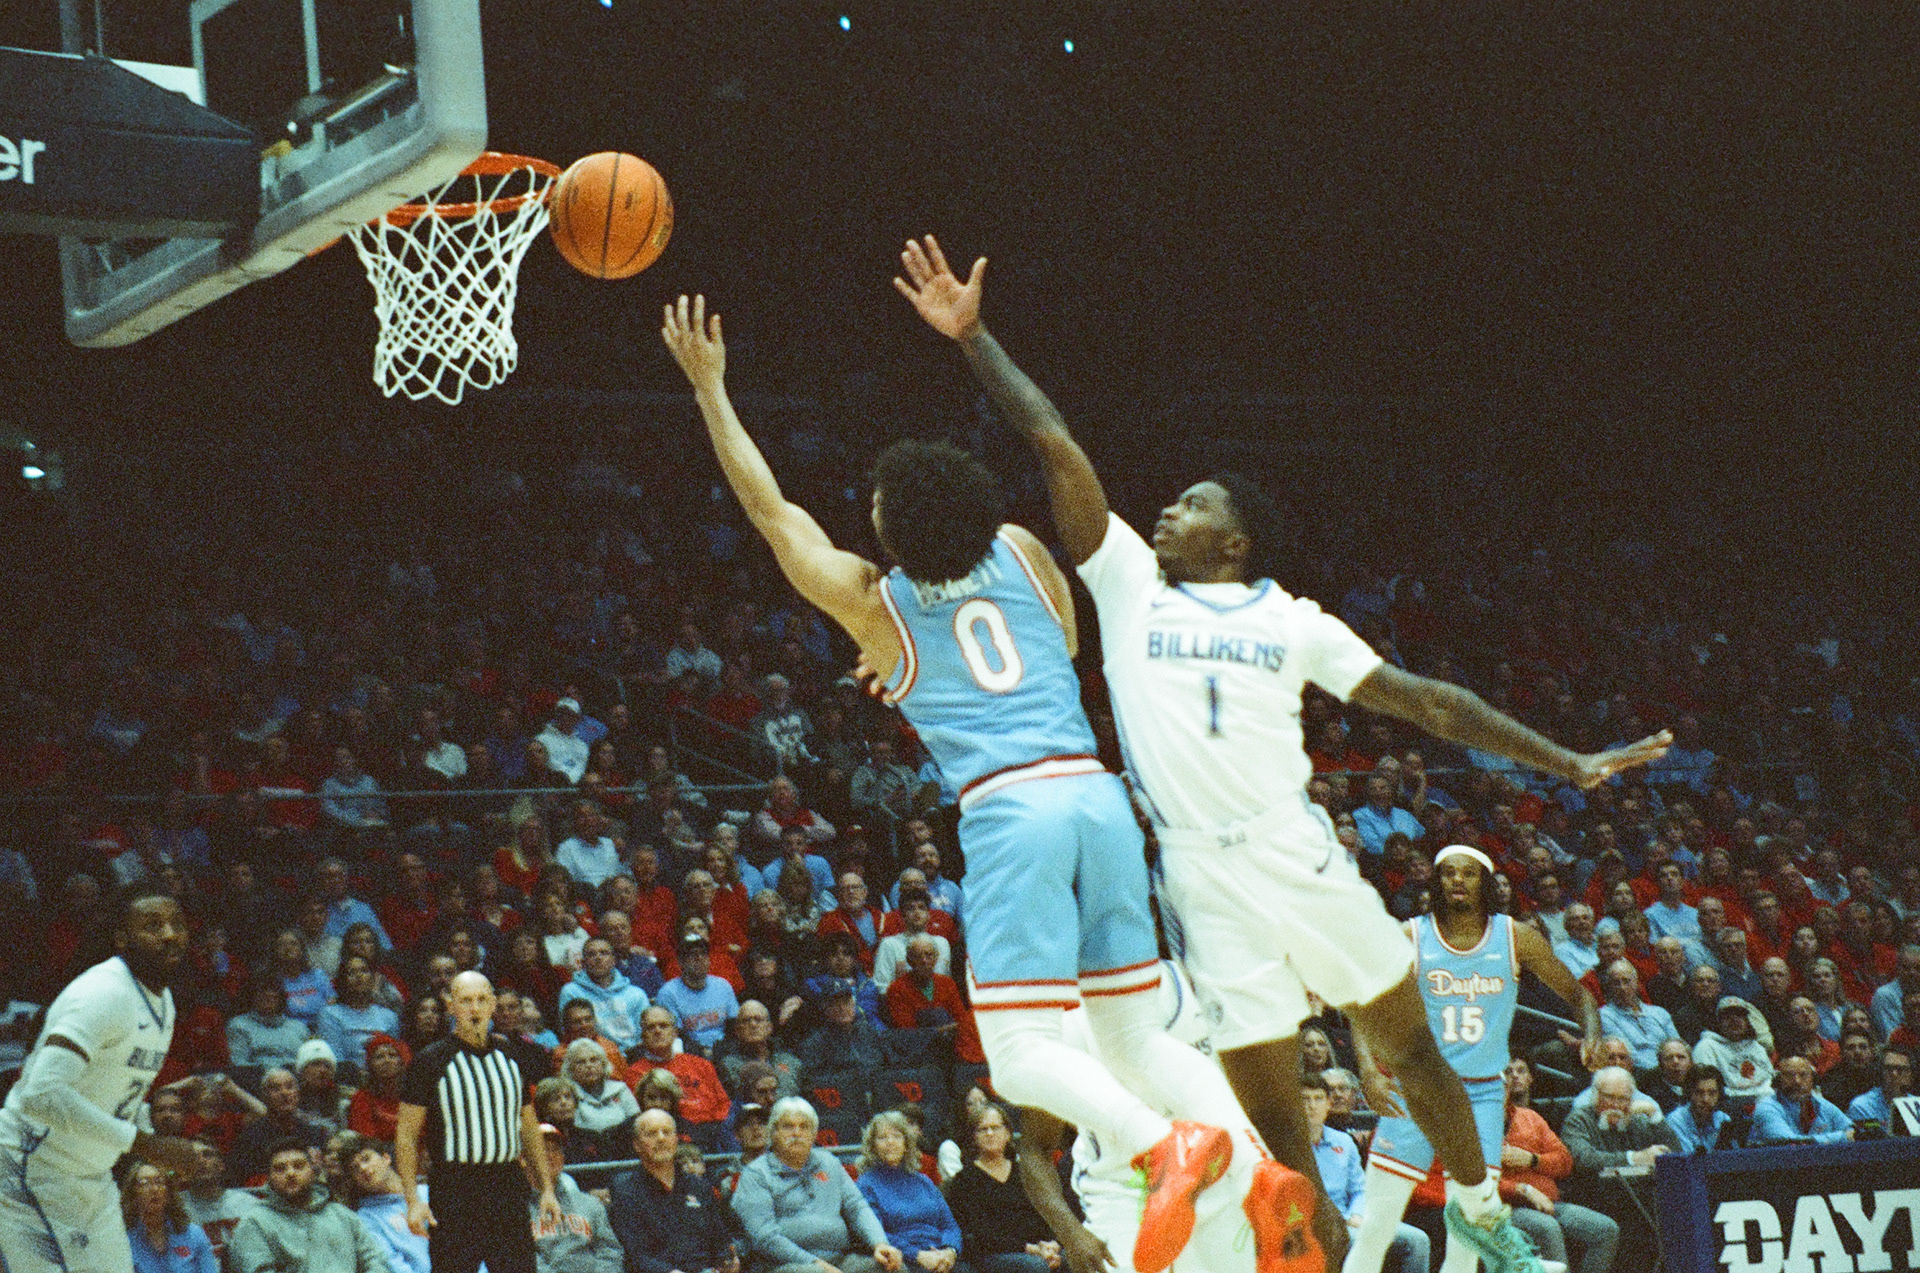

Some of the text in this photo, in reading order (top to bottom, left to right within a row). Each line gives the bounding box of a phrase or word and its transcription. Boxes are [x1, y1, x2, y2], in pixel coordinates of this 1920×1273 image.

[952, 597, 1023, 694] 0
[1148, 631, 1287, 673] BILLIKENS
[1206, 675, 1224, 739] 1
[1426, 968, 1505, 1002] Dayton
[1442, 1005, 1486, 1045] 15
